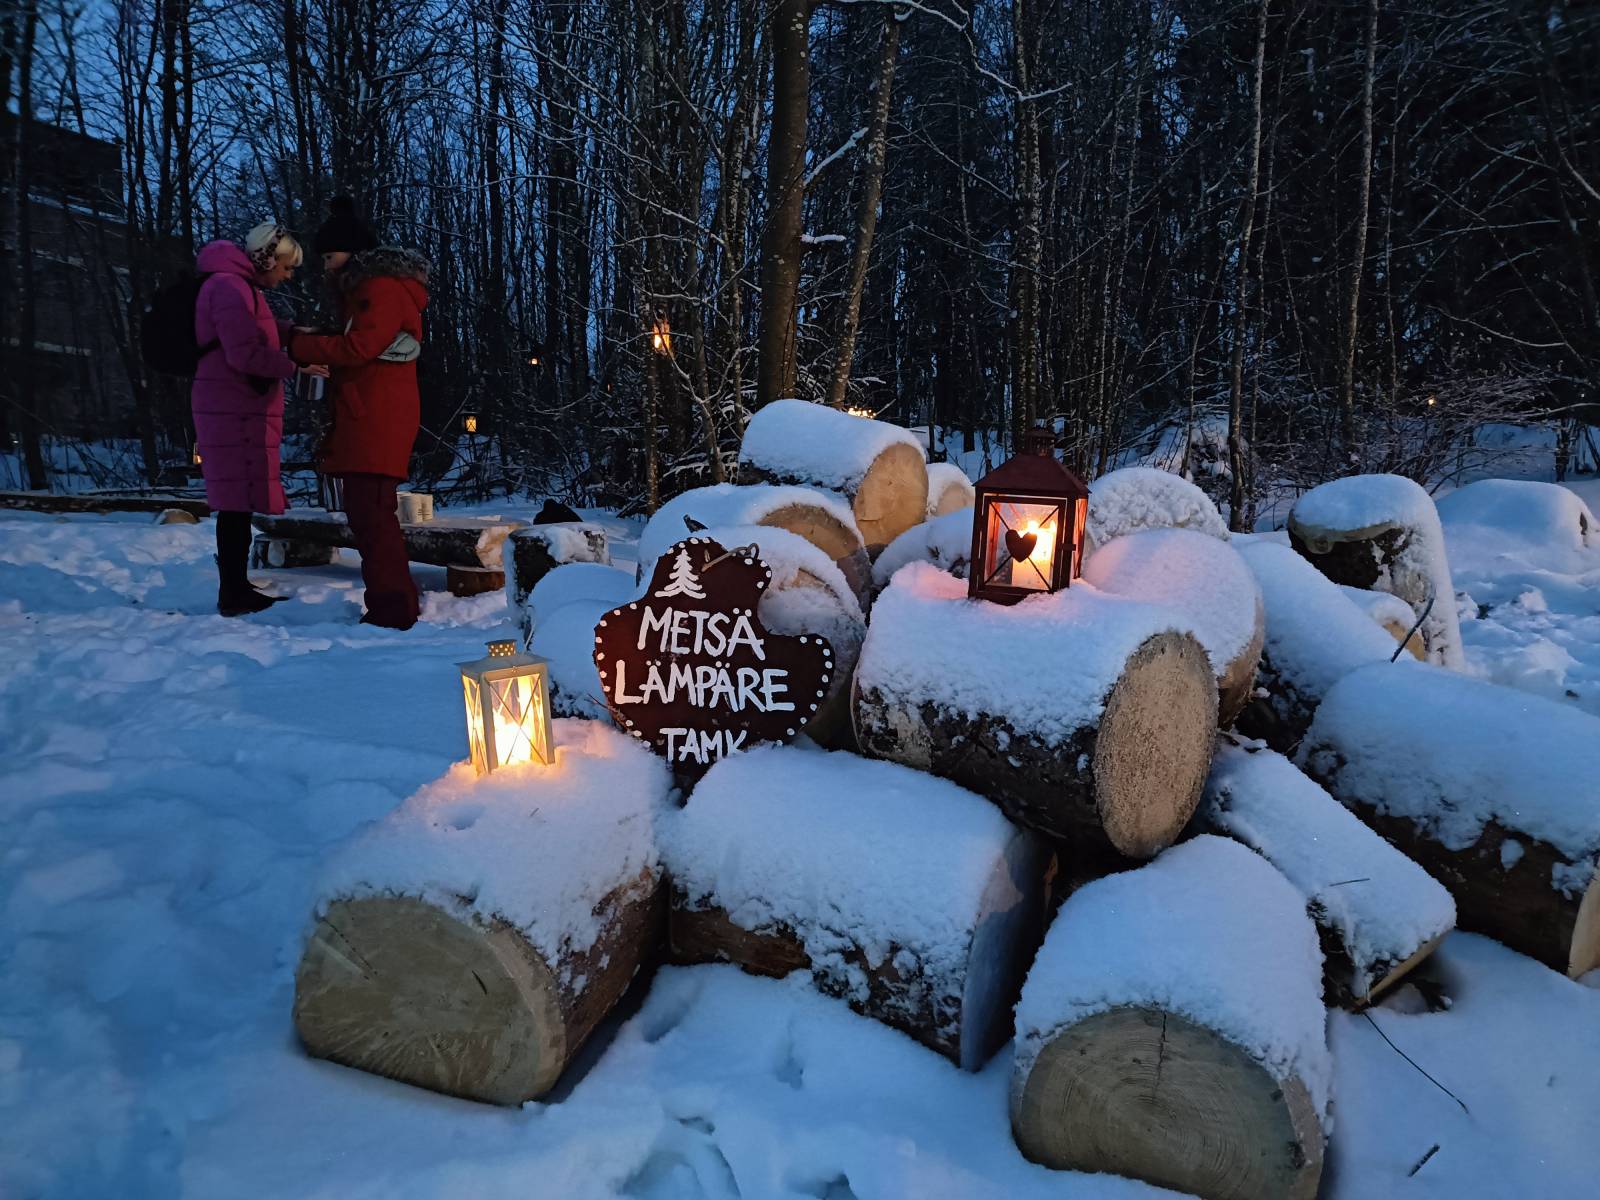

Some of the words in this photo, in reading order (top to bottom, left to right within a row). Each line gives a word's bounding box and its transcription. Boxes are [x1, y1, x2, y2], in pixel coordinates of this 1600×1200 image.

[637, 605, 765, 660] METSÄ
[614, 660, 795, 712] LÄMPÄRE
[659, 727, 747, 764] TAMK
